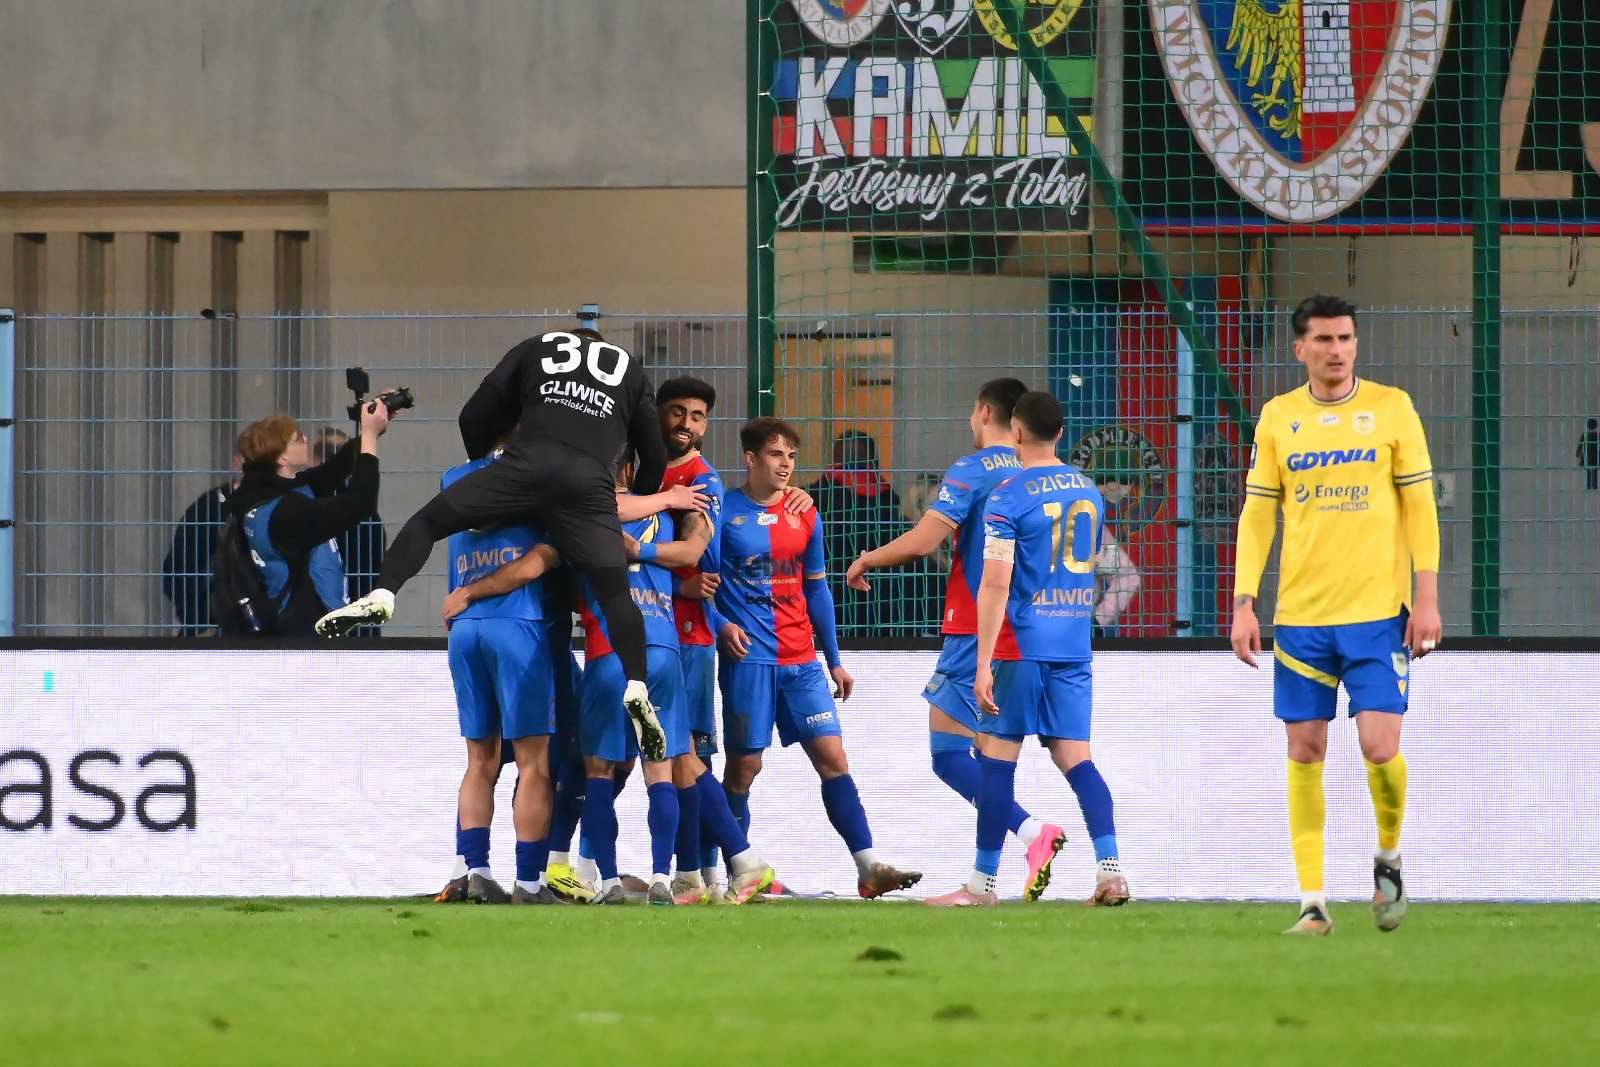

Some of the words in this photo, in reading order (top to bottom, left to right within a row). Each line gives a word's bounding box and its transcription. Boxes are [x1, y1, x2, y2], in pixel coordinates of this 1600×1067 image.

[796, 57, 1070, 157] KAMIL
[1228, 141, 1339, 210] KLUB
[1340, 0, 1438, 181] SPORTO
[775, 153, 956, 228] Jesteśmy
[960, 173, 988, 206] z
[994, 150, 1087, 216] Tobą
[541, 331, 630, 387] 30
[540, 380, 616, 416] GLIWICE
[1287, 448, 1377, 472] GDYNIA
[1315, 485, 1369, 501] Energa
[1043, 499, 1097, 574] 10
[0, 749, 197, 832] asa
